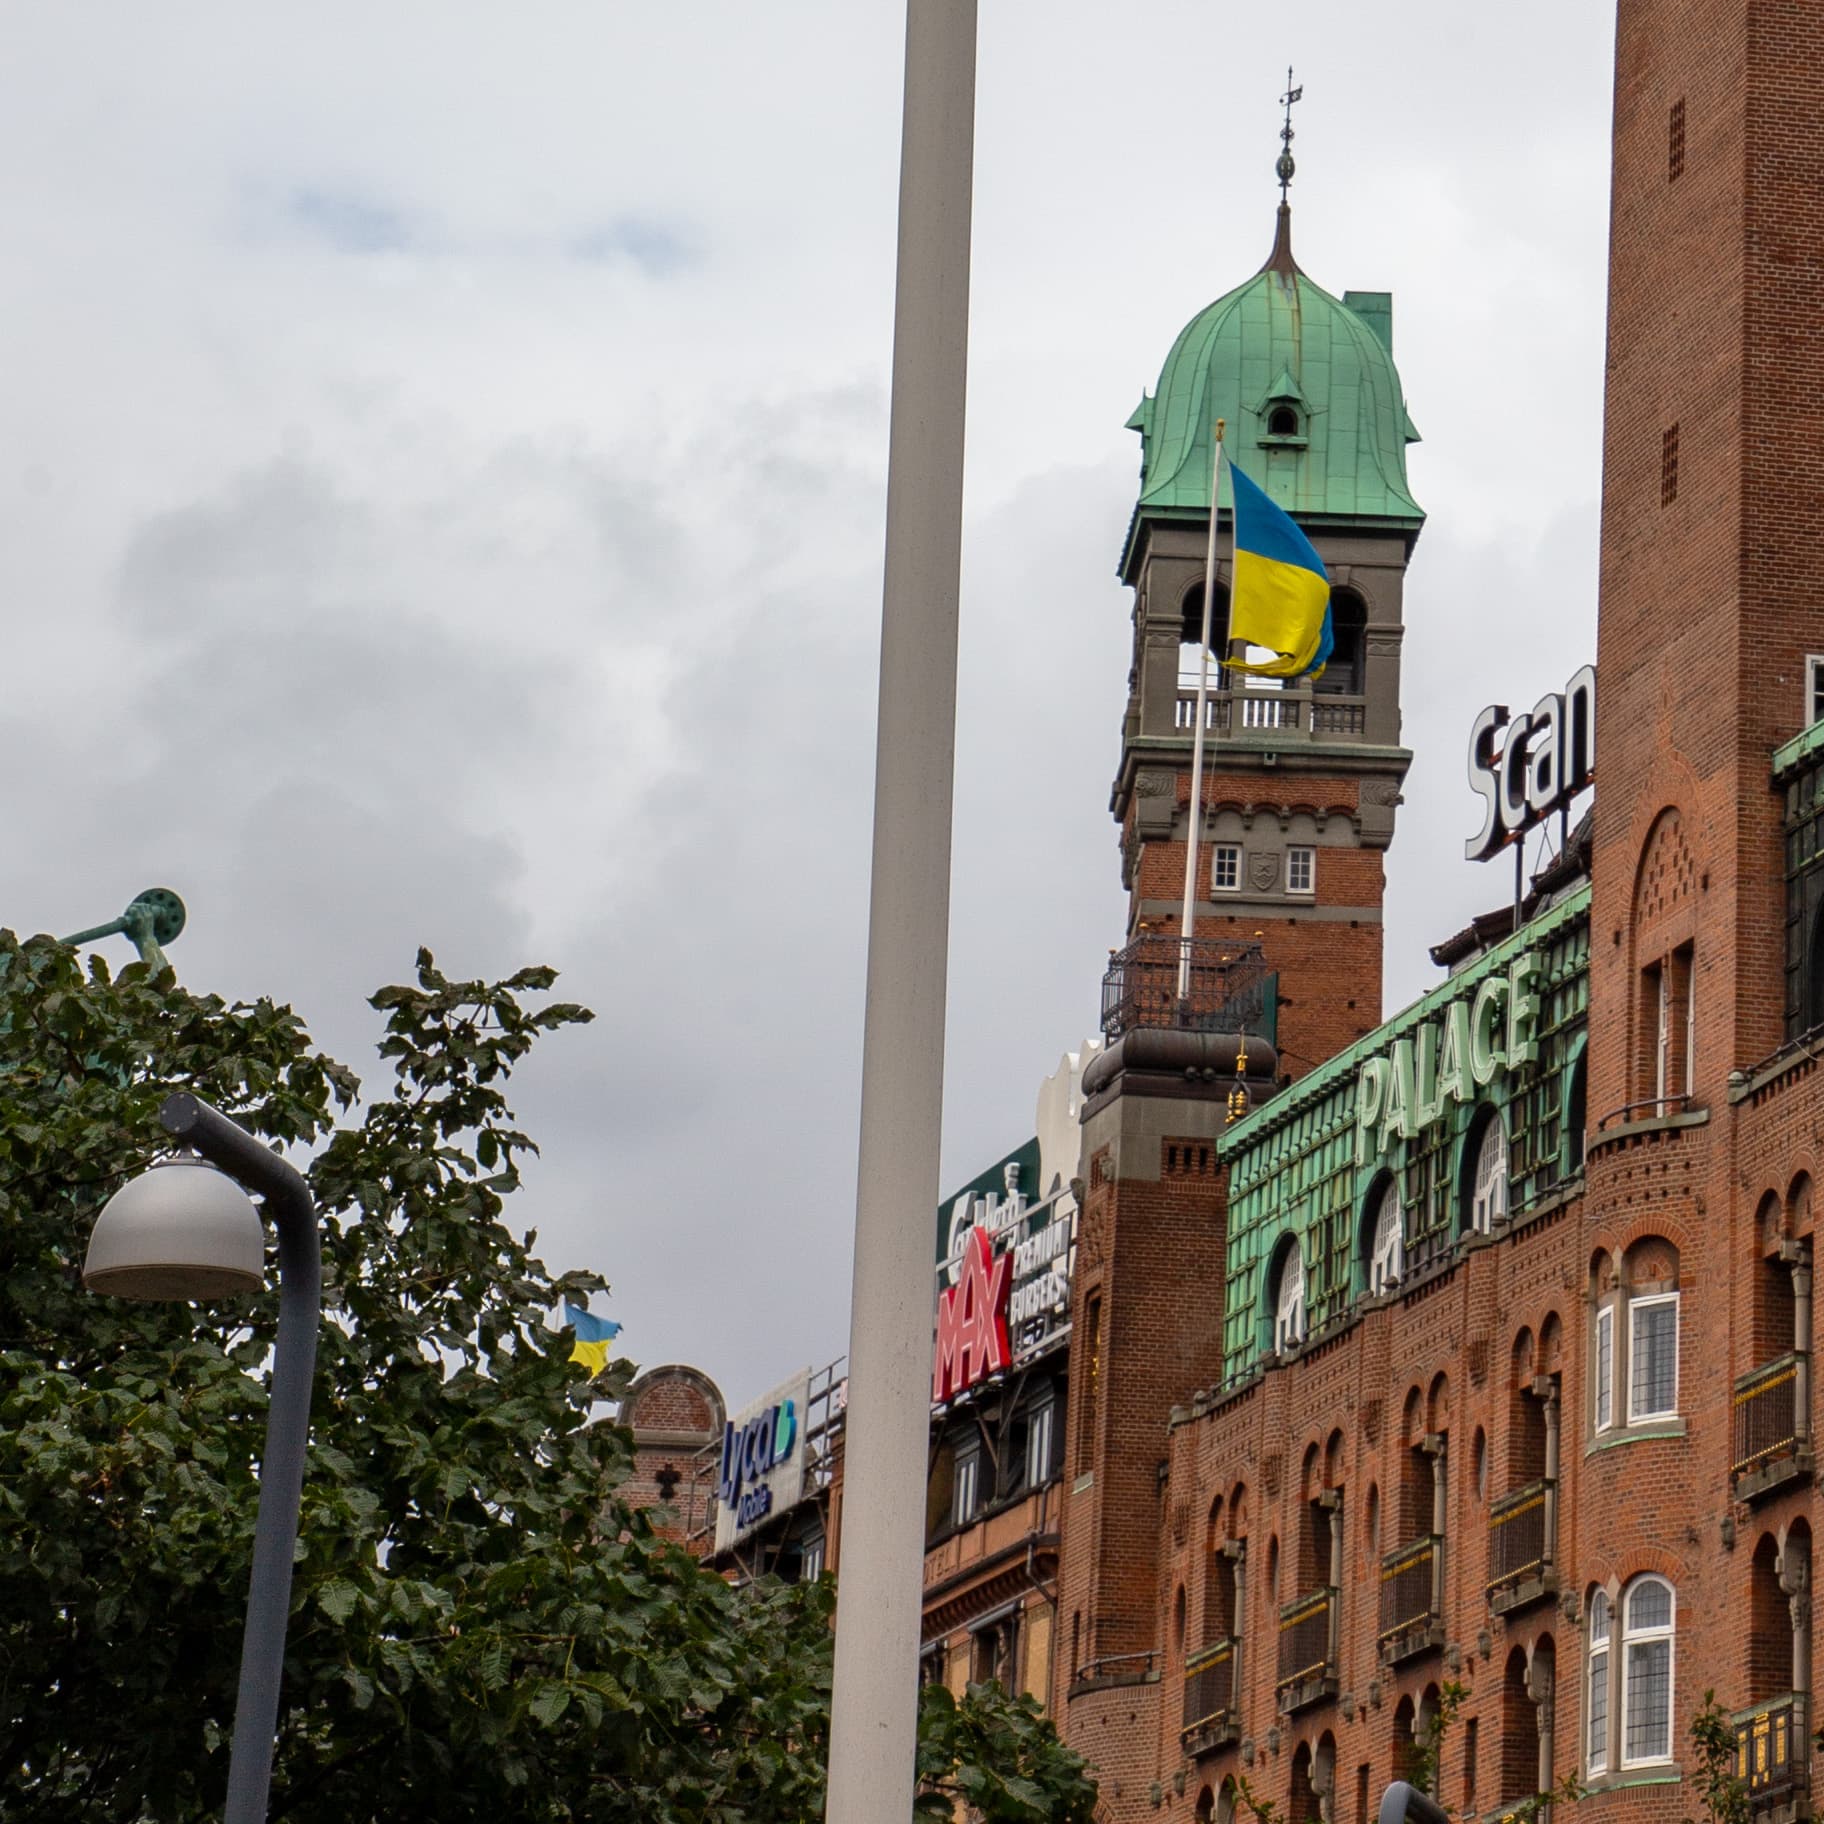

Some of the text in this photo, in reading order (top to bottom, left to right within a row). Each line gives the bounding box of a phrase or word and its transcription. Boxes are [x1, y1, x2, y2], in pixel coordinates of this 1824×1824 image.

[1354, 952, 1541, 1167] PALACE
[1009, 1267, 1068, 1327] BURGERS
[1012, 1219, 1070, 1280] PREMIUM
[933, 1225, 1011, 1402] MAX
